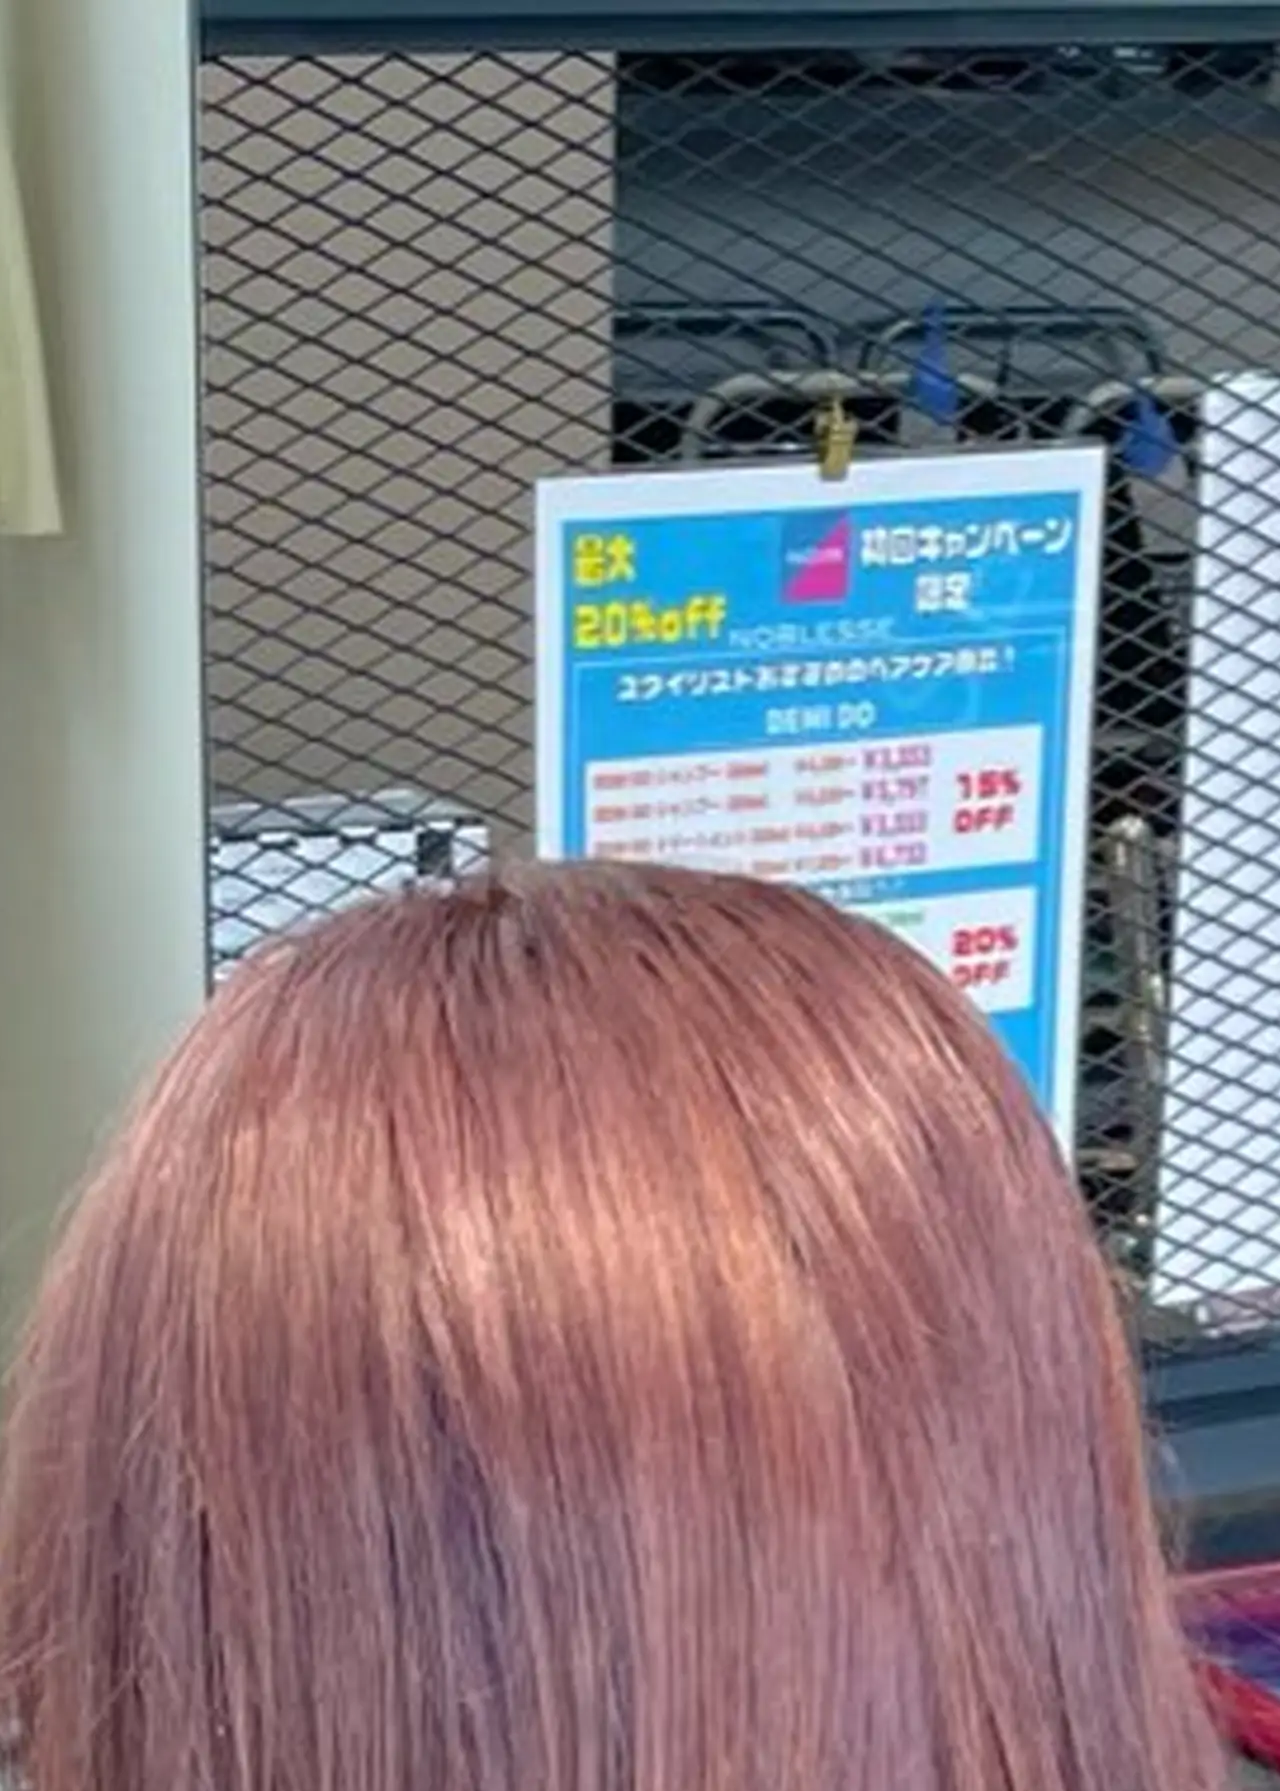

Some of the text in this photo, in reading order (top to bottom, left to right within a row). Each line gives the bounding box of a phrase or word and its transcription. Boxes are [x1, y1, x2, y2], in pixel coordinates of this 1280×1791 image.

[576, 534, 635, 588] 最大
[575, 594, 726, 649] 20%off
[953, 804, 1015, 835] OFF
[951, 925, 1020, 958] 20%
